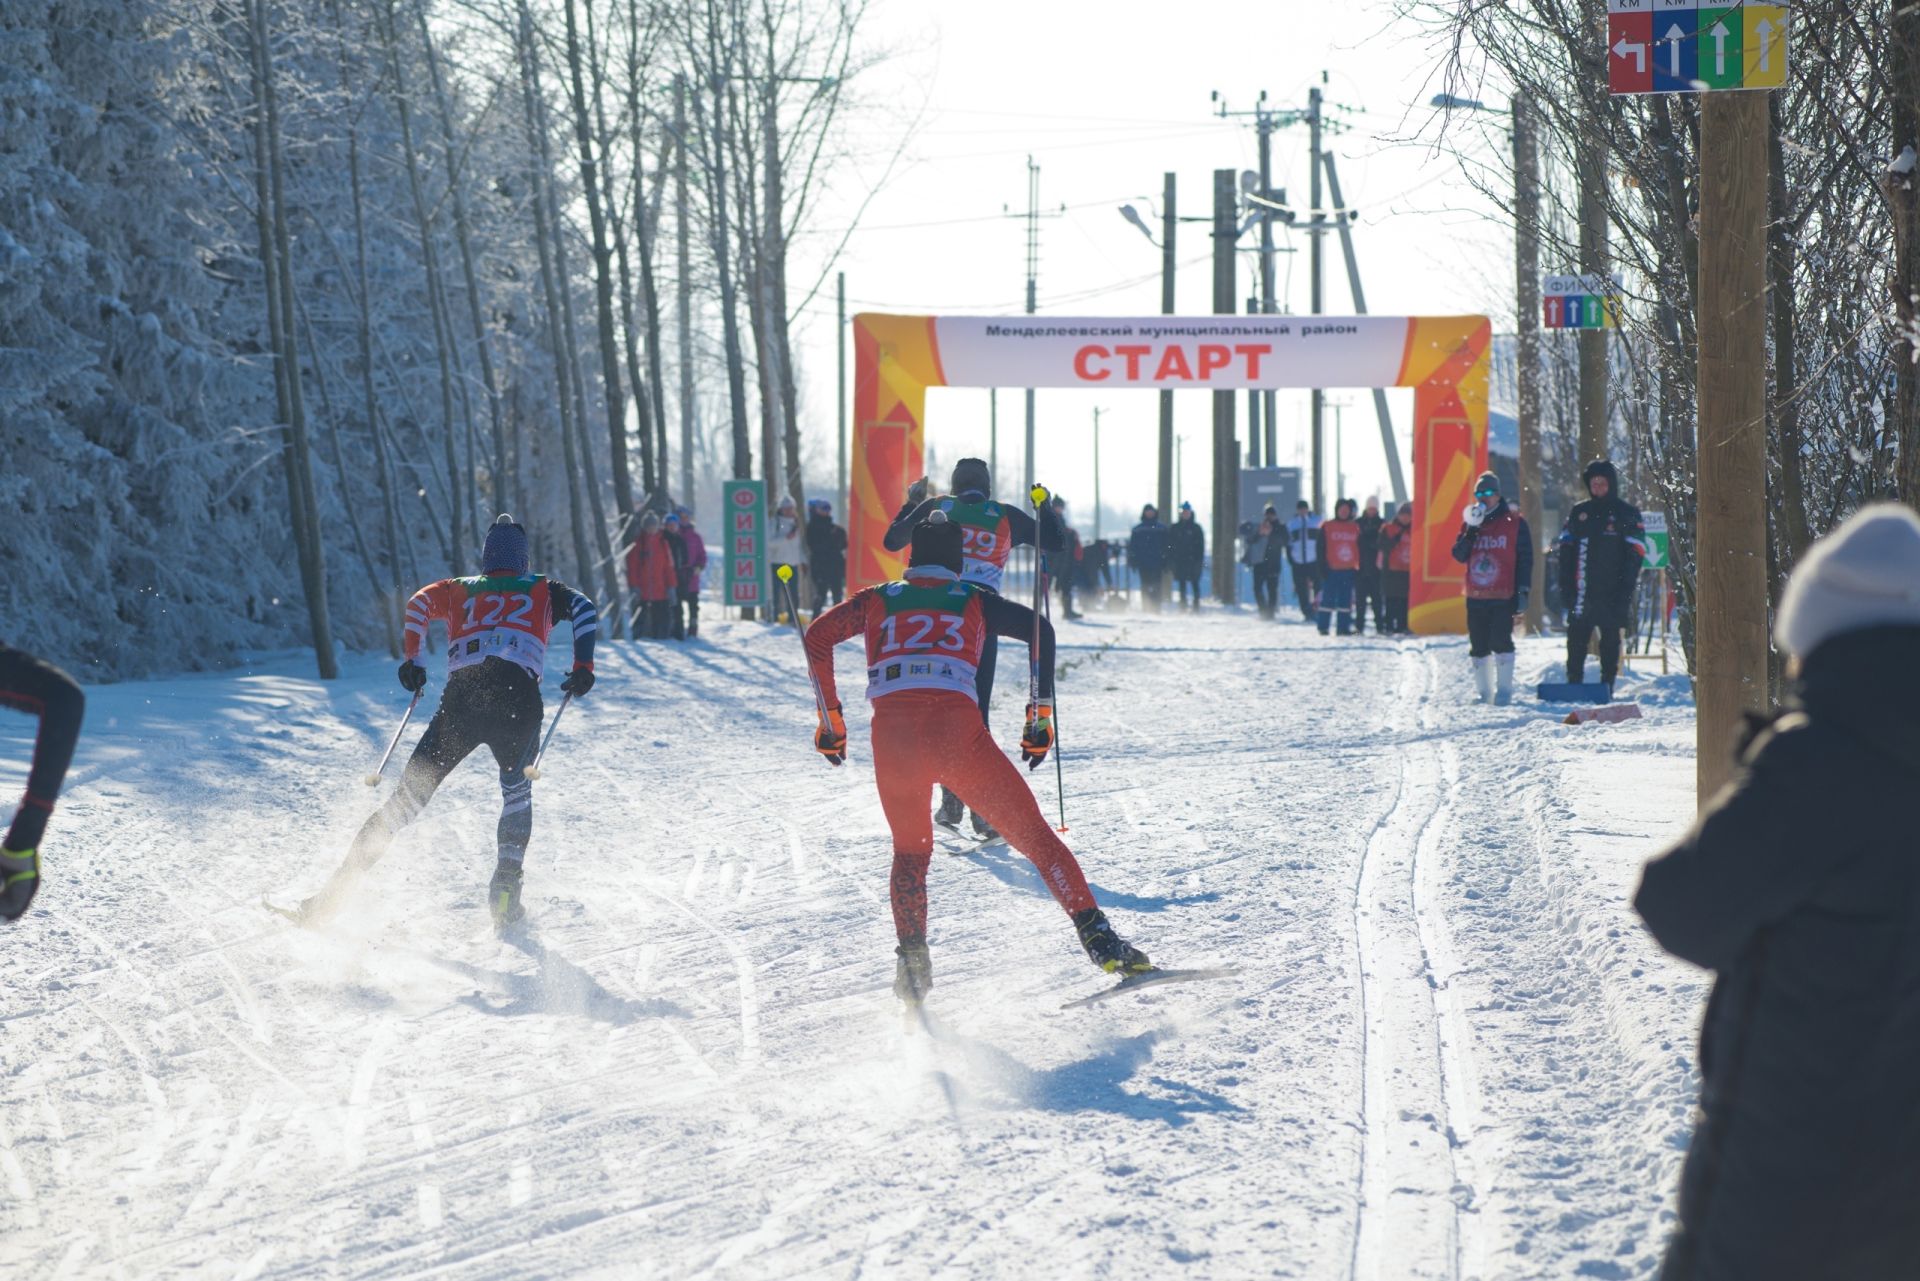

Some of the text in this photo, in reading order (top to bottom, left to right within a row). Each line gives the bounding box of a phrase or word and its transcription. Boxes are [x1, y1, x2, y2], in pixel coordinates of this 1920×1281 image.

[985, 324, 1358, 338] Менделеевский муниципальный район
[1073, 344, 1272, 381] СТАРТ
[734, 489, 757, 600] ФИНИШ
[462, 593, 533, 630] 122
[880, 614, 965, 653] 123
